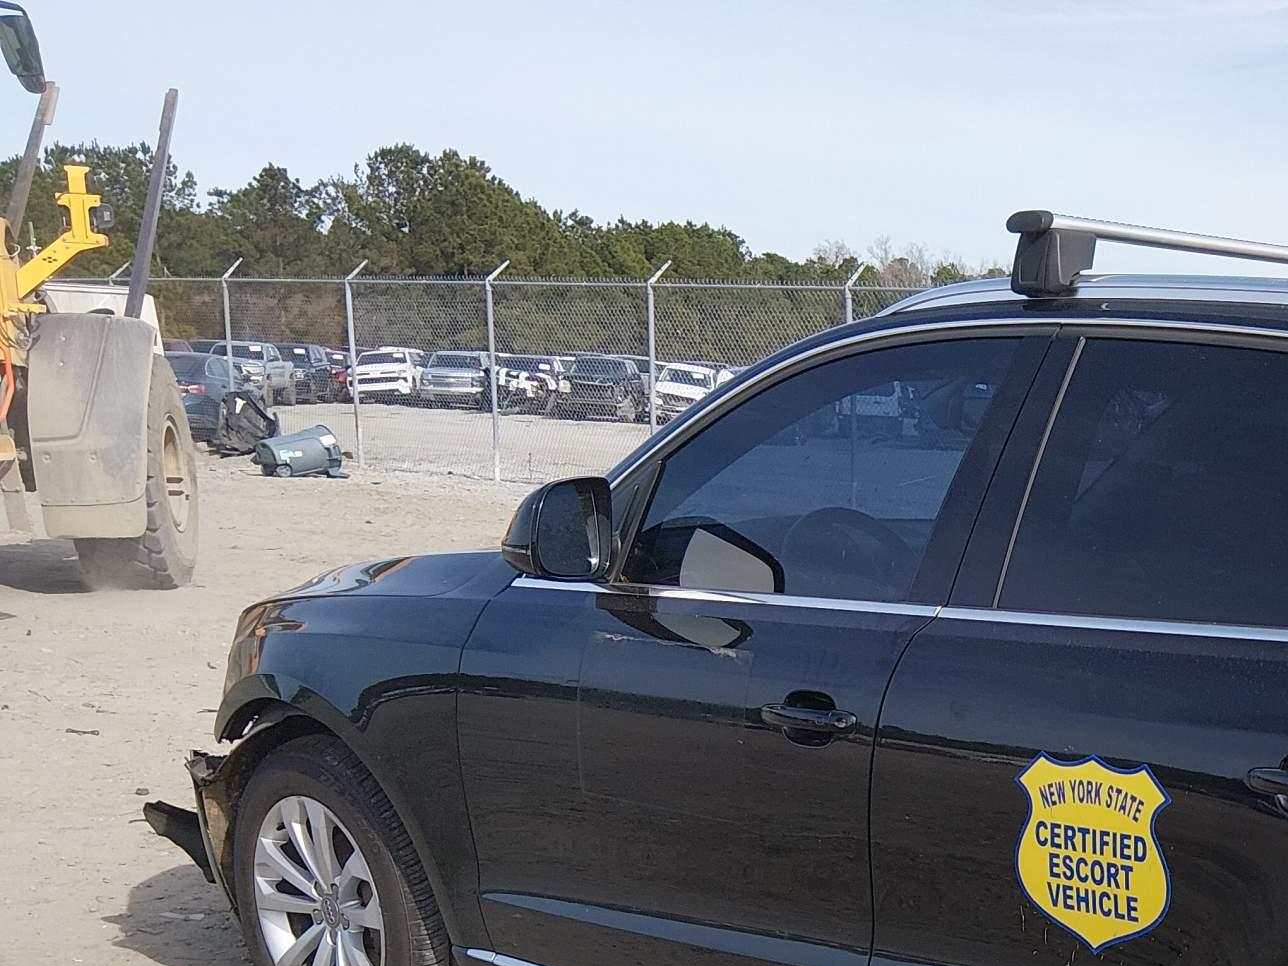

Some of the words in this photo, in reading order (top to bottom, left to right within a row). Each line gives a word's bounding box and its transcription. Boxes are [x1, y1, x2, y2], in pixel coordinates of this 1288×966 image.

[1039, 781, 1066, 809] NEW
[1069, 779, 1103, 806] YORK
[1105, 785, 1145, 823] STATE
[1035, 820, 1147, 862] CERTIFIED
[1048, 852, 1134, 891] ESCORT
[1047, 881, 1139, 923] VEHICLE
